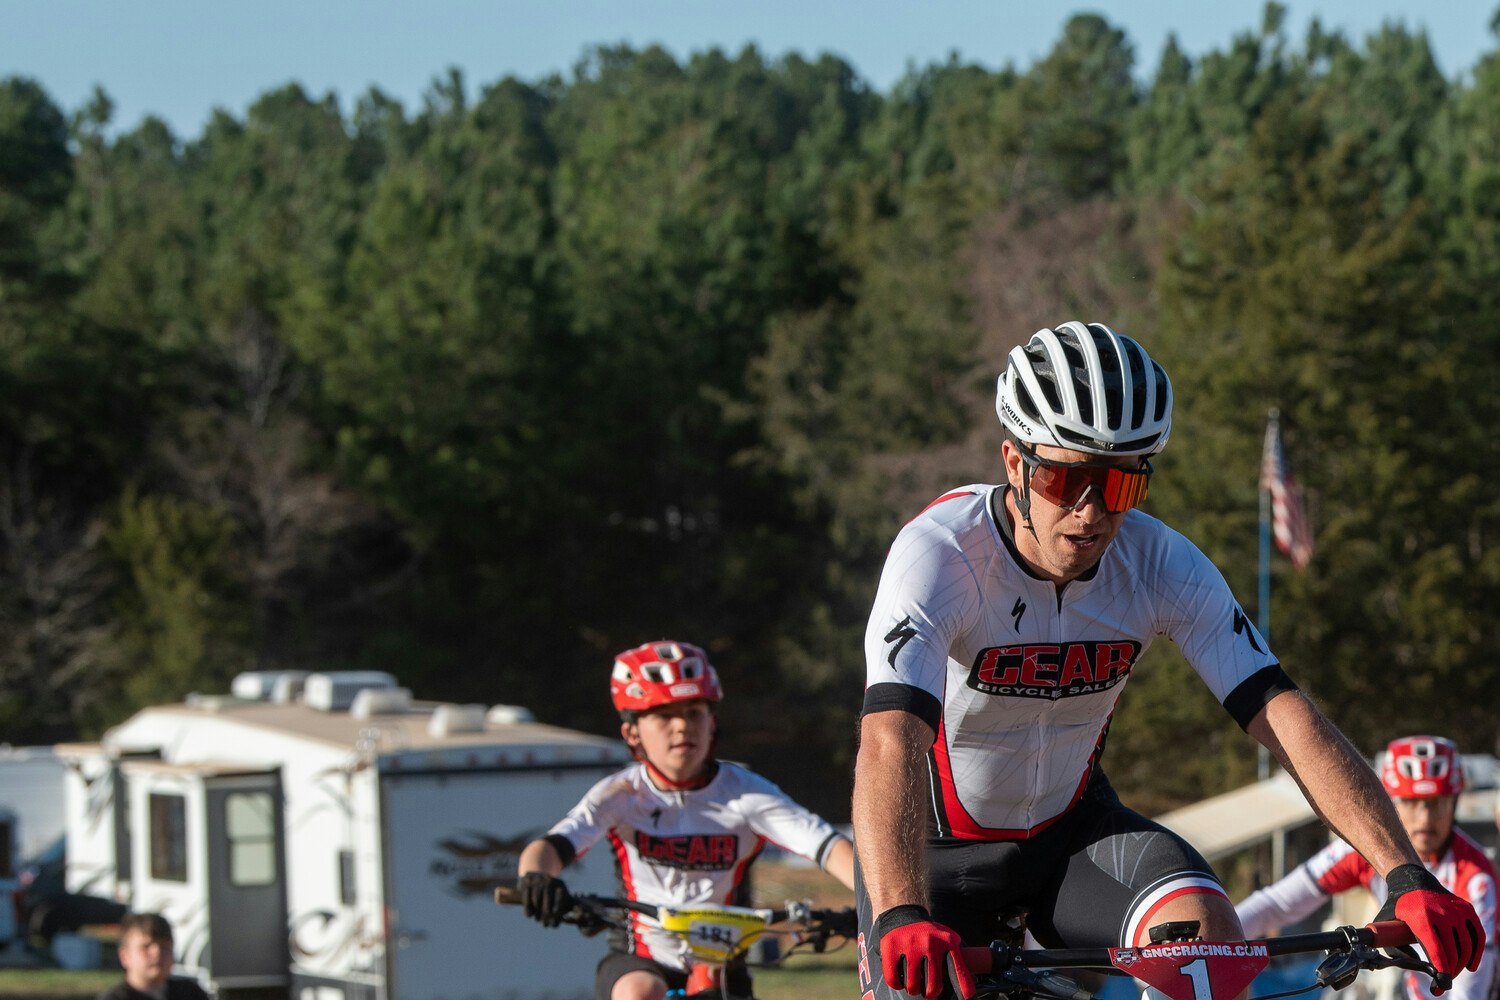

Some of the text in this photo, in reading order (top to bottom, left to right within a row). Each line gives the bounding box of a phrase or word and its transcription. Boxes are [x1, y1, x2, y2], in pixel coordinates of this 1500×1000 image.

[977, 642, 1135, 687] GEAR
[976, 683, 1062, 699] BICYCLE
[1142, 945, 1268, 959] GNCCRACING.COM
